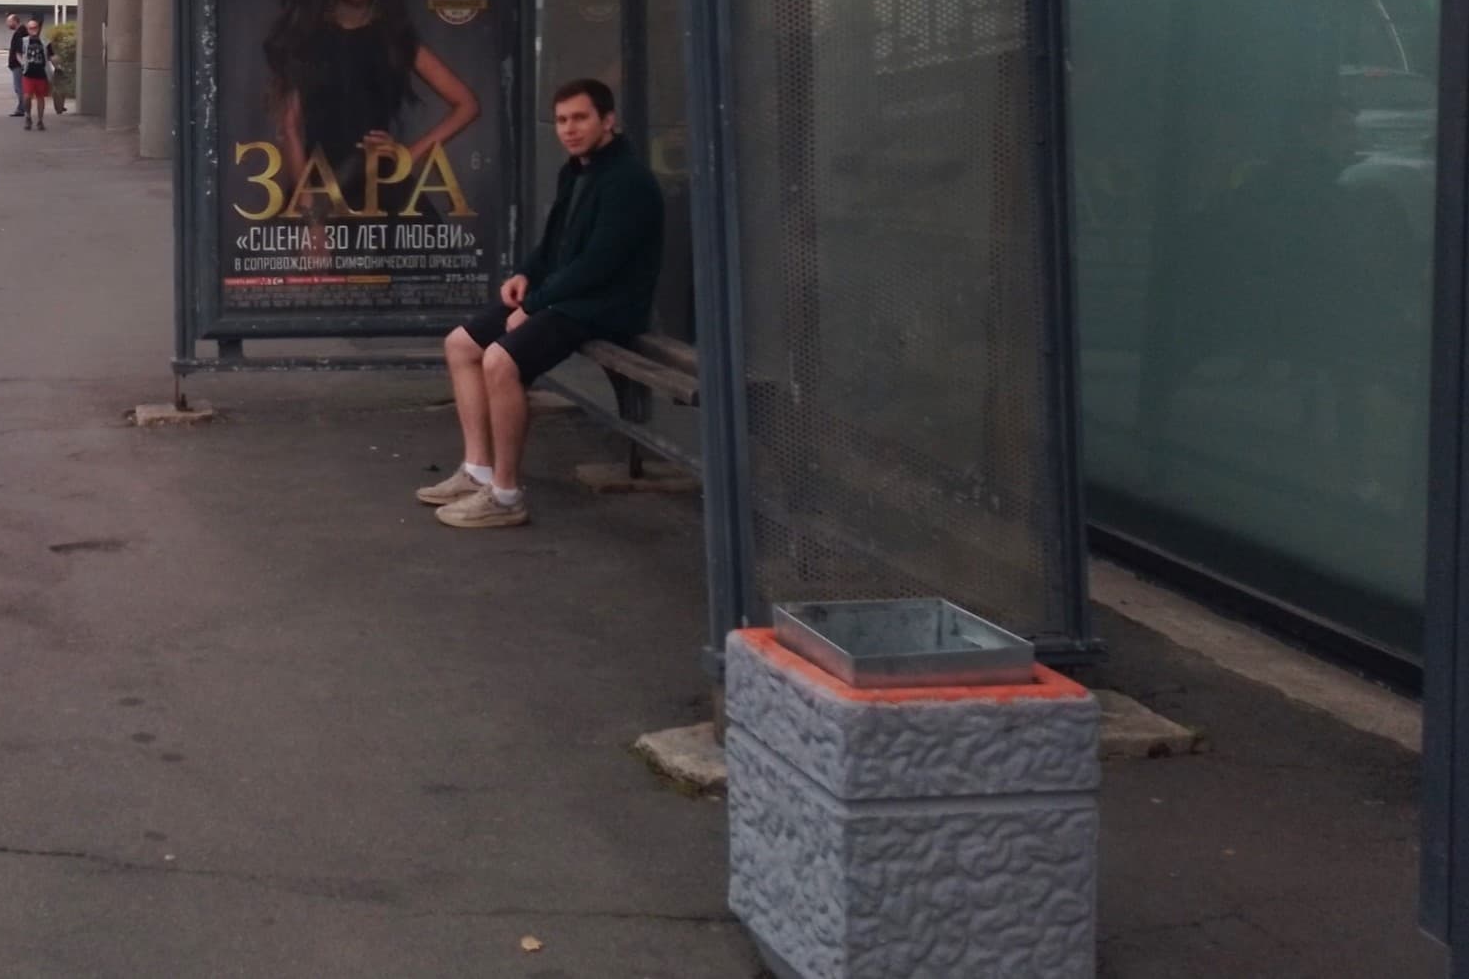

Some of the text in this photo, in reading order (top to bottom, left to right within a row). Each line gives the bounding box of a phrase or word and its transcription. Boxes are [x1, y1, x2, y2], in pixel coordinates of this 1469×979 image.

[233, 140, 479, 221] ЗАРА
[235, 224, 476, 251] «СЦЕНА: 30 ЛЕТ ЛЮБВИ»
[234, 254, 477, 271] В СОПРОВОЖДЕНИИ СИМФОНИЧЕСКОГО ОРКЕСТРА
